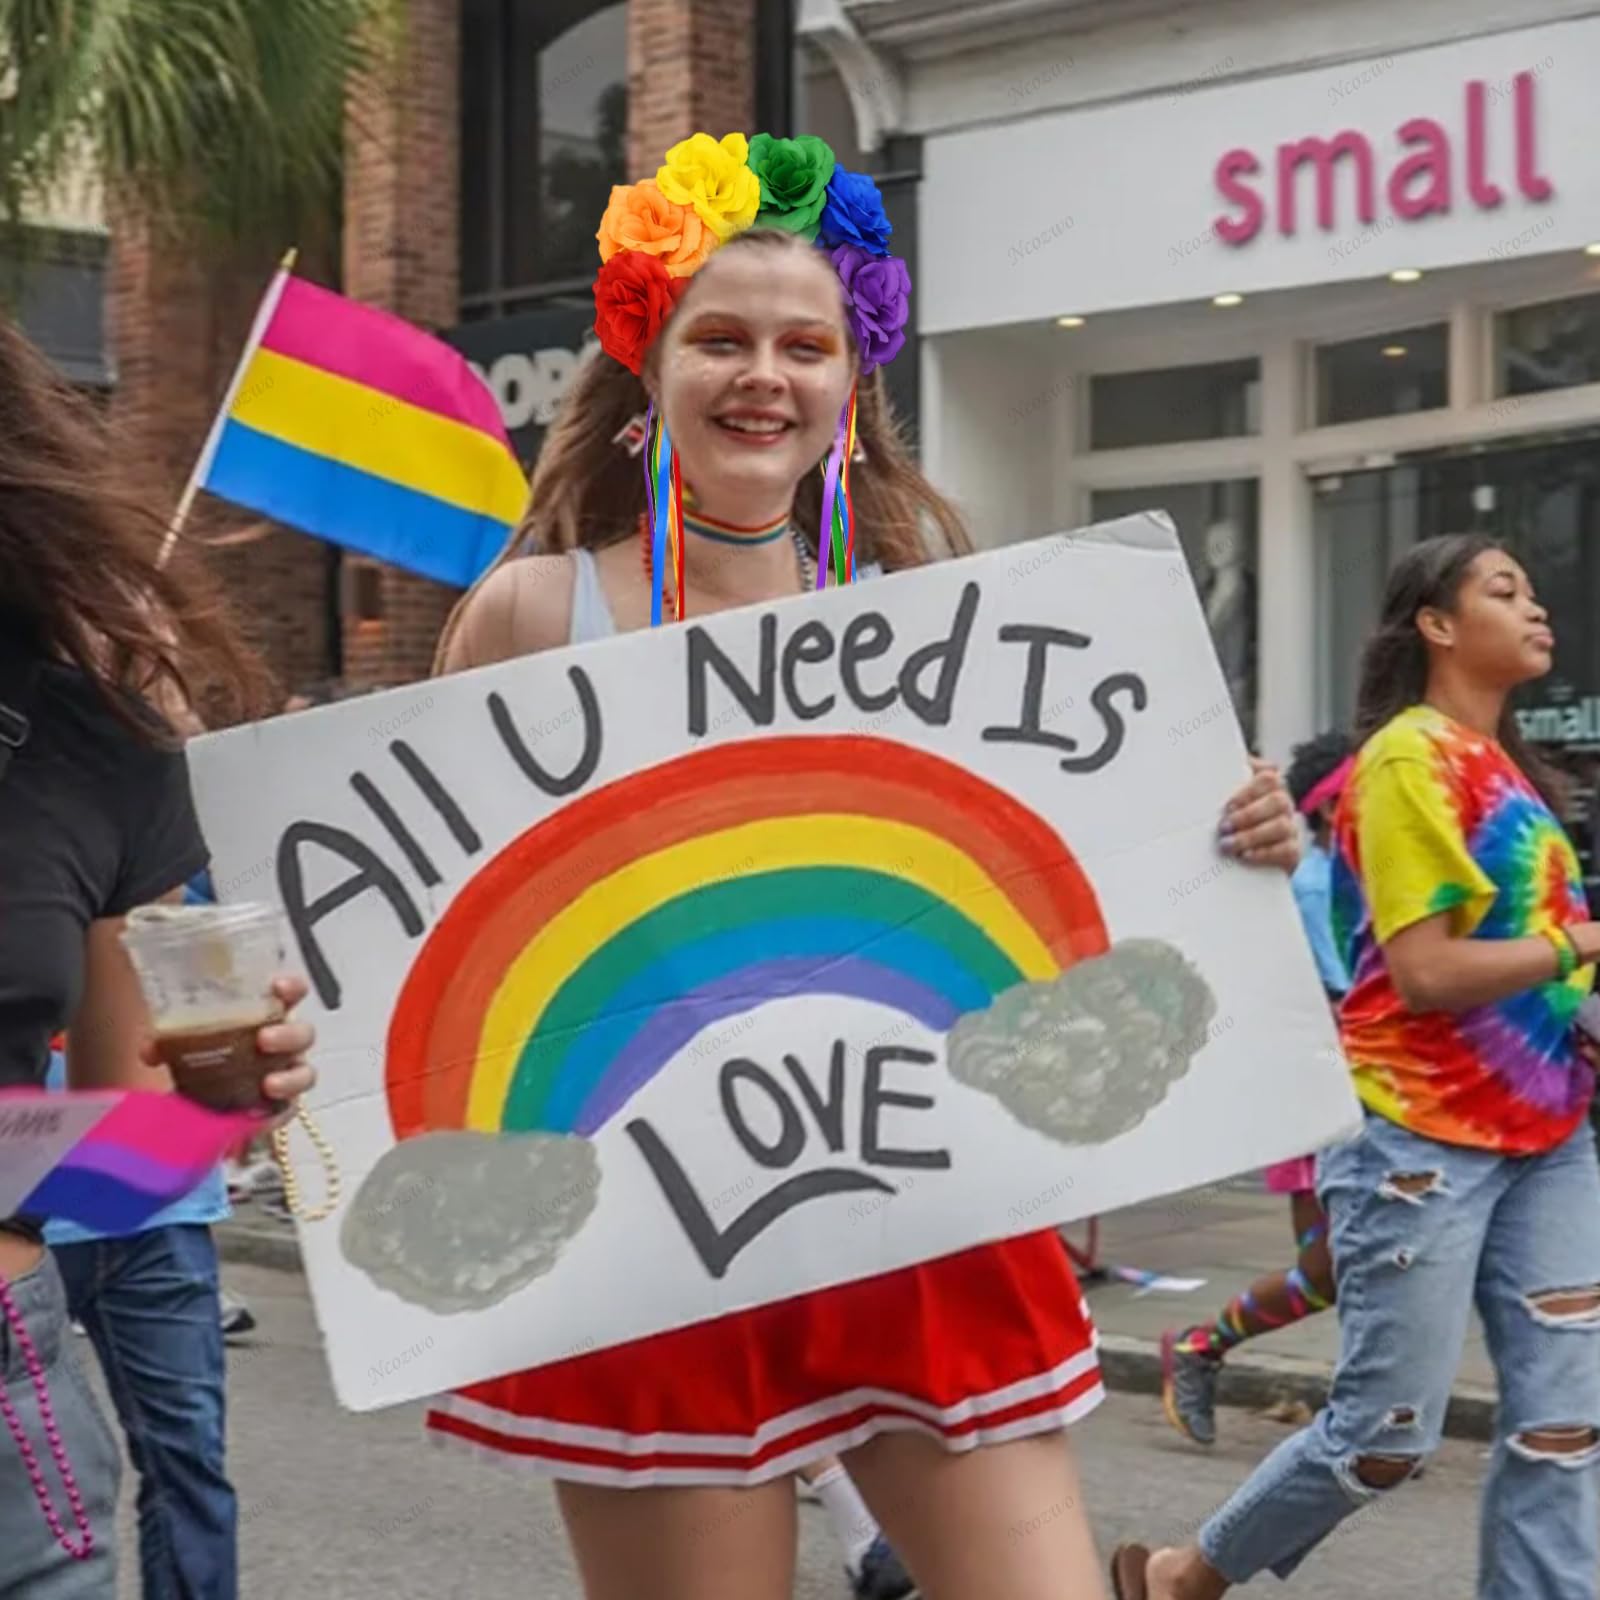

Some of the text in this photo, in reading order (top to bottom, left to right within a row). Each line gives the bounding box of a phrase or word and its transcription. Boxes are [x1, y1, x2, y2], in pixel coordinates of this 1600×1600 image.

[1214, 70, 1555, 246] small
[276, 581, 1148, 1010] All U Need Is
[625, 1038, 952, 1280] LOVE
